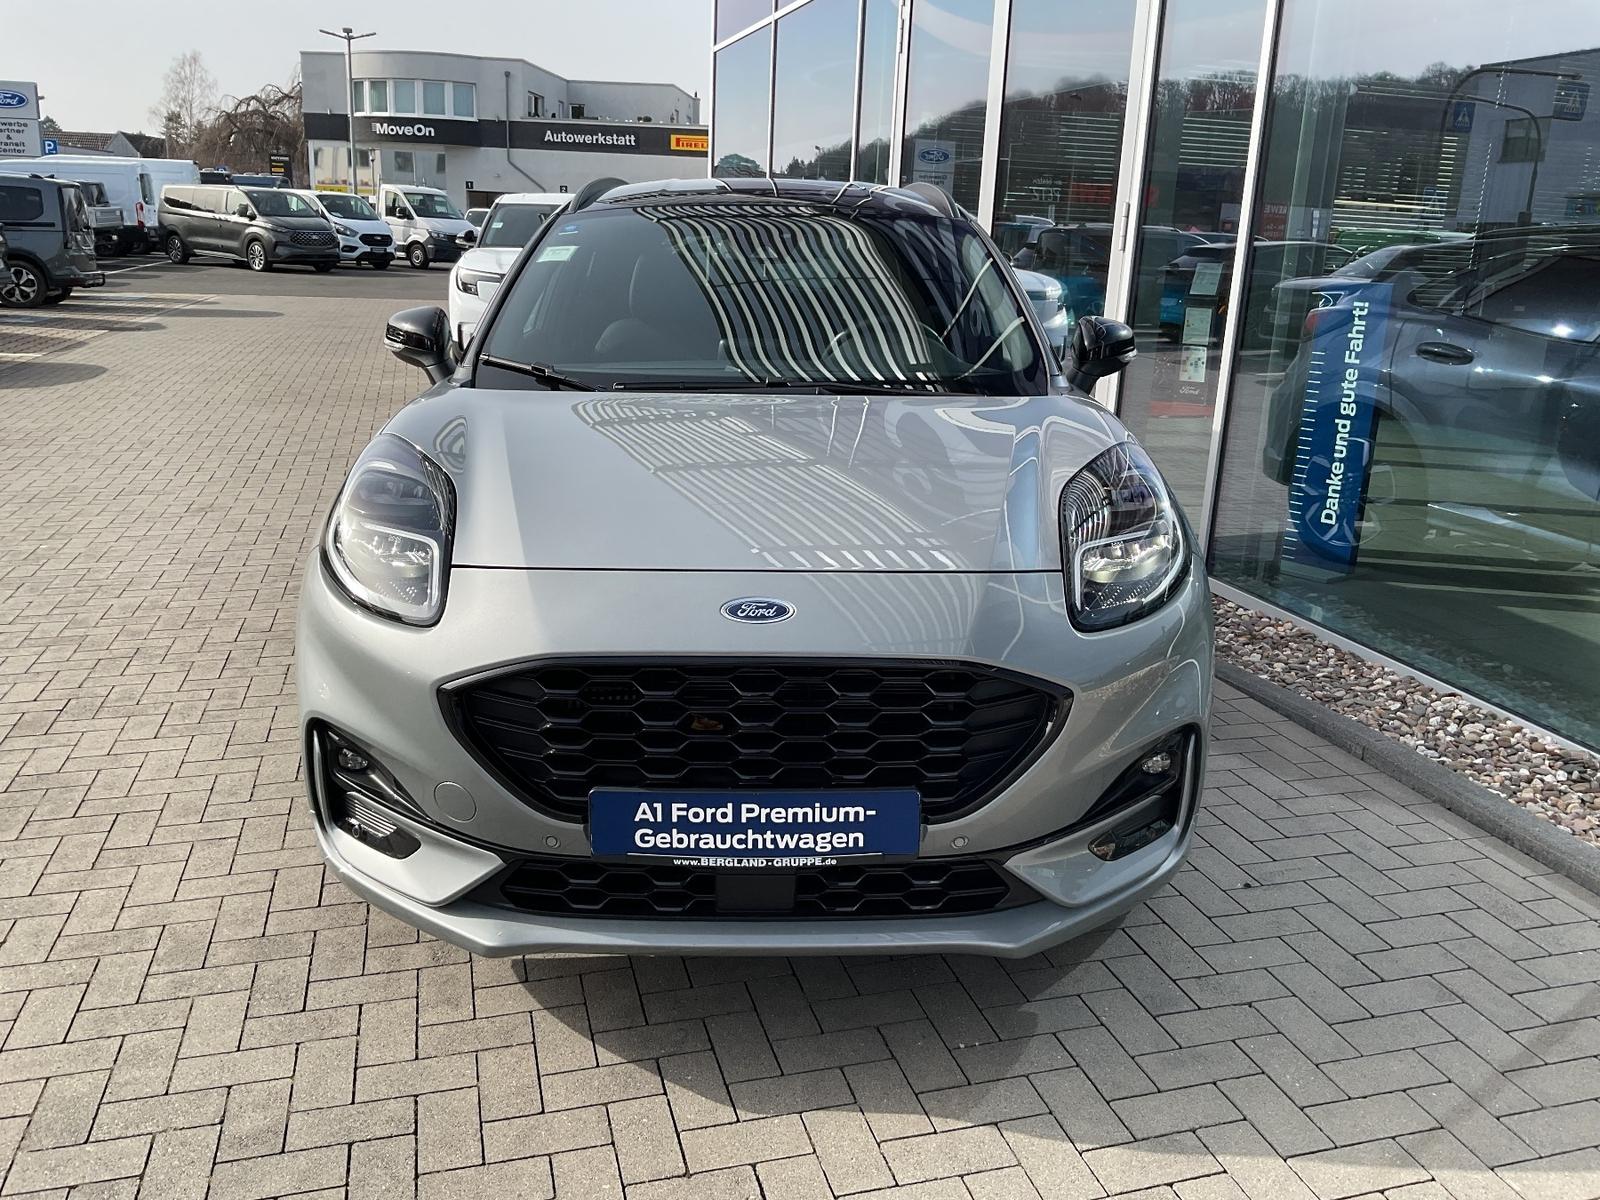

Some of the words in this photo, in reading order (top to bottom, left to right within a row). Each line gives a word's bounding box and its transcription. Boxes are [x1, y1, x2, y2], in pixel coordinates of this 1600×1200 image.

[375, 122, 435, 137] MoveOn
[544, 130, 636, 146] Autowerkstatt
[44, 140, 54, 153] P
[1344, 300, 1370, 365] Fahrt!
[1340, 366, 1359, 417] gute
[1334, 418, 1351, 459] und
[1320, 457, 1345, 526] Danke
[737, 602, 777, 617] Ford
[634, 802, 663, 823] A1
[671, 802, 733, 824] Ford
[741, 802, 877, 824] Premium-
[634, 828, 865, 853] Gebrauchtwagen
[673, 857, 837, 867] www.BERGLAND-GRUPPE.de
